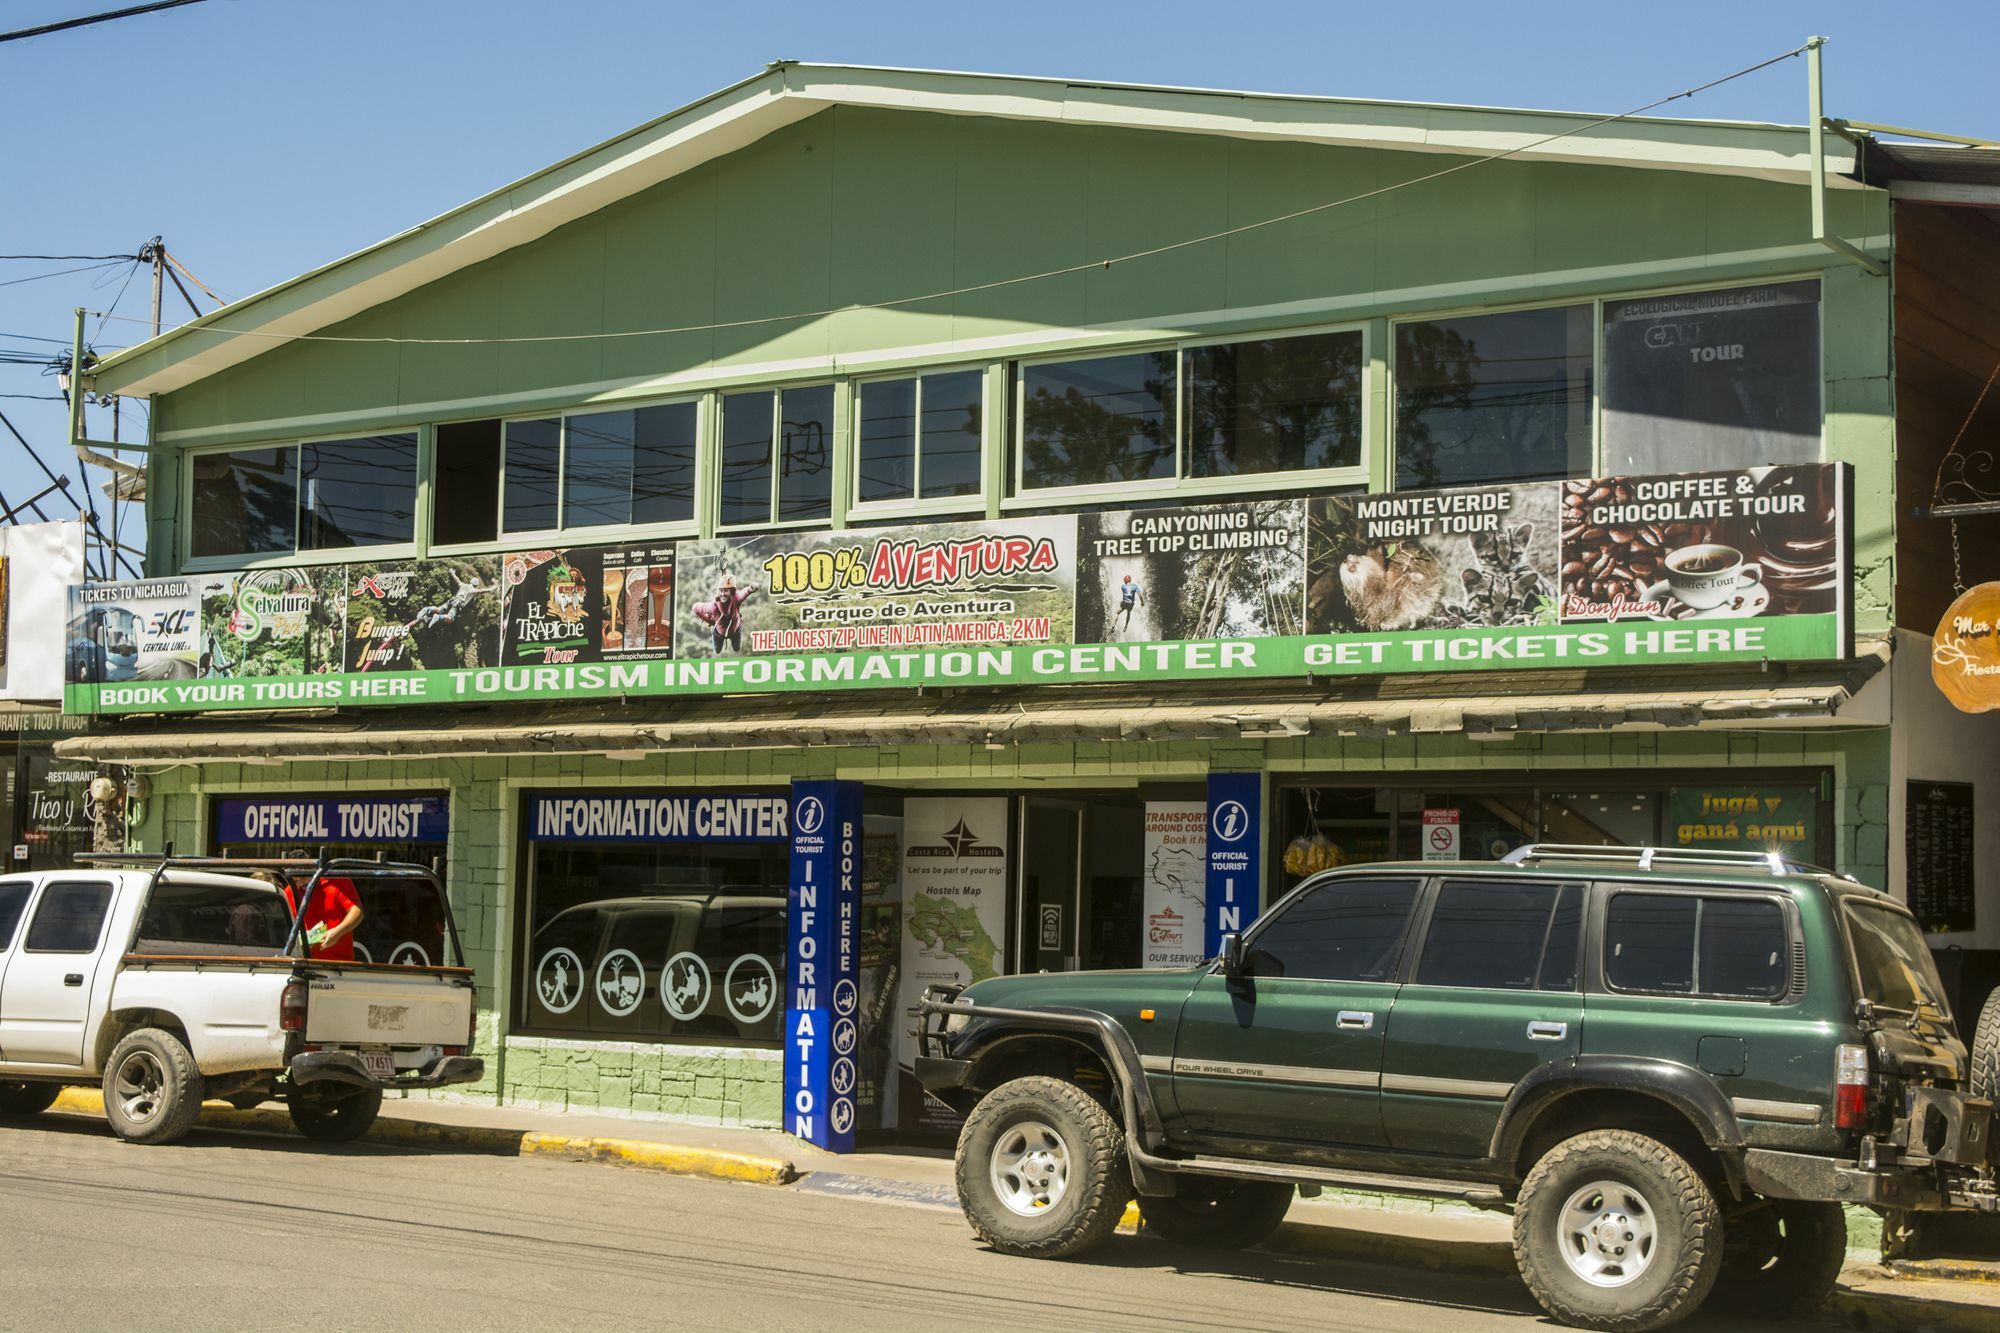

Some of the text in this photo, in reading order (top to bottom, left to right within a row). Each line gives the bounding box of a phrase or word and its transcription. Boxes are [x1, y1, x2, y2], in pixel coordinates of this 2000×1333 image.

[1690, 344, 1744, 363] TOUR
[1637, 476, 1754, 500] COFFEE &
[1357, 492, 1511, 520] MONTEVERDE
[1593, 494, 1806, 525] CHOCOLATE TOUR
[1130, 513, 1249, 536] CANYONING
[1368, 513, 1498, 538] NIGHT TOUR
[1094, 529, 1288, 556] TREE TOP CLIMBING
[764, 535, 1059, 594] 100% AVENTURA
[80, 583, 189, 602] TICKETS TO NICARAGUA
[1711, 576, 1735, 588] Tour
[238, 588, 310, 640] Selvatura
[527, 601, 545, 619] EL
[801, 598, 1012, 622] Parque de Aventura
[1567, 592, 1660, 621] Don Juan
[356, 616, 410, 643] Bungee
[752, 618, 1050, 651] THE LONGEST ZIP LINE IN LATIN AMERICA: 2KM
[1953, 615, 1990, 634] Mar
[143, 642, 169, 653] CENTRAL
[170, 641, 185, 652] LINE
[356, 640, 395, 669] Jump
[543, 645, 579, 664] Tour
[603, 652, 667, 662] www.eltrapichetour.com
[100, 626, 1766, 706] BOOK YOUR TOURS HERE TOURISM INFORMATION CENTER GET TICKETS HERE
[33, 713, 53, 731] TICO
[55, 713, 61, 731] Y
[31, 790, 61, 820] Tico
[65, 800, 74, 826] y
[537, 798, 788, 837] INFORMATION CENTER
[244, 802, 423, 839] OFFICIAL TOURIST
[1145, 823, 1183, 832] AROUND
[795, 836, 825, 844] OFFICIAL
[1163, 835, 1188, 844] Book
[1189, 835, 1196, 844] it
[1211, 852, 1249, 860] OFFICIAL
[1211, 862, 1247, 870] TOURIST
[933, 866, 942, 874] be
[943, 866, 959, 875] part
[960, 866, 969, 874] of
[969, 867, 987, 877] your
[841, 822, 853, 972] BOOK HERE
[926, 886, 982, 897] Hostels Map
[1149, 953, 1168, 962] OUR
[310, 983, 336, 991] HILUX
[795, 860, 817, 1140] INFORMATION
[1176, 1064, 1264, 1076] FOUR WHEEL DRIVE
